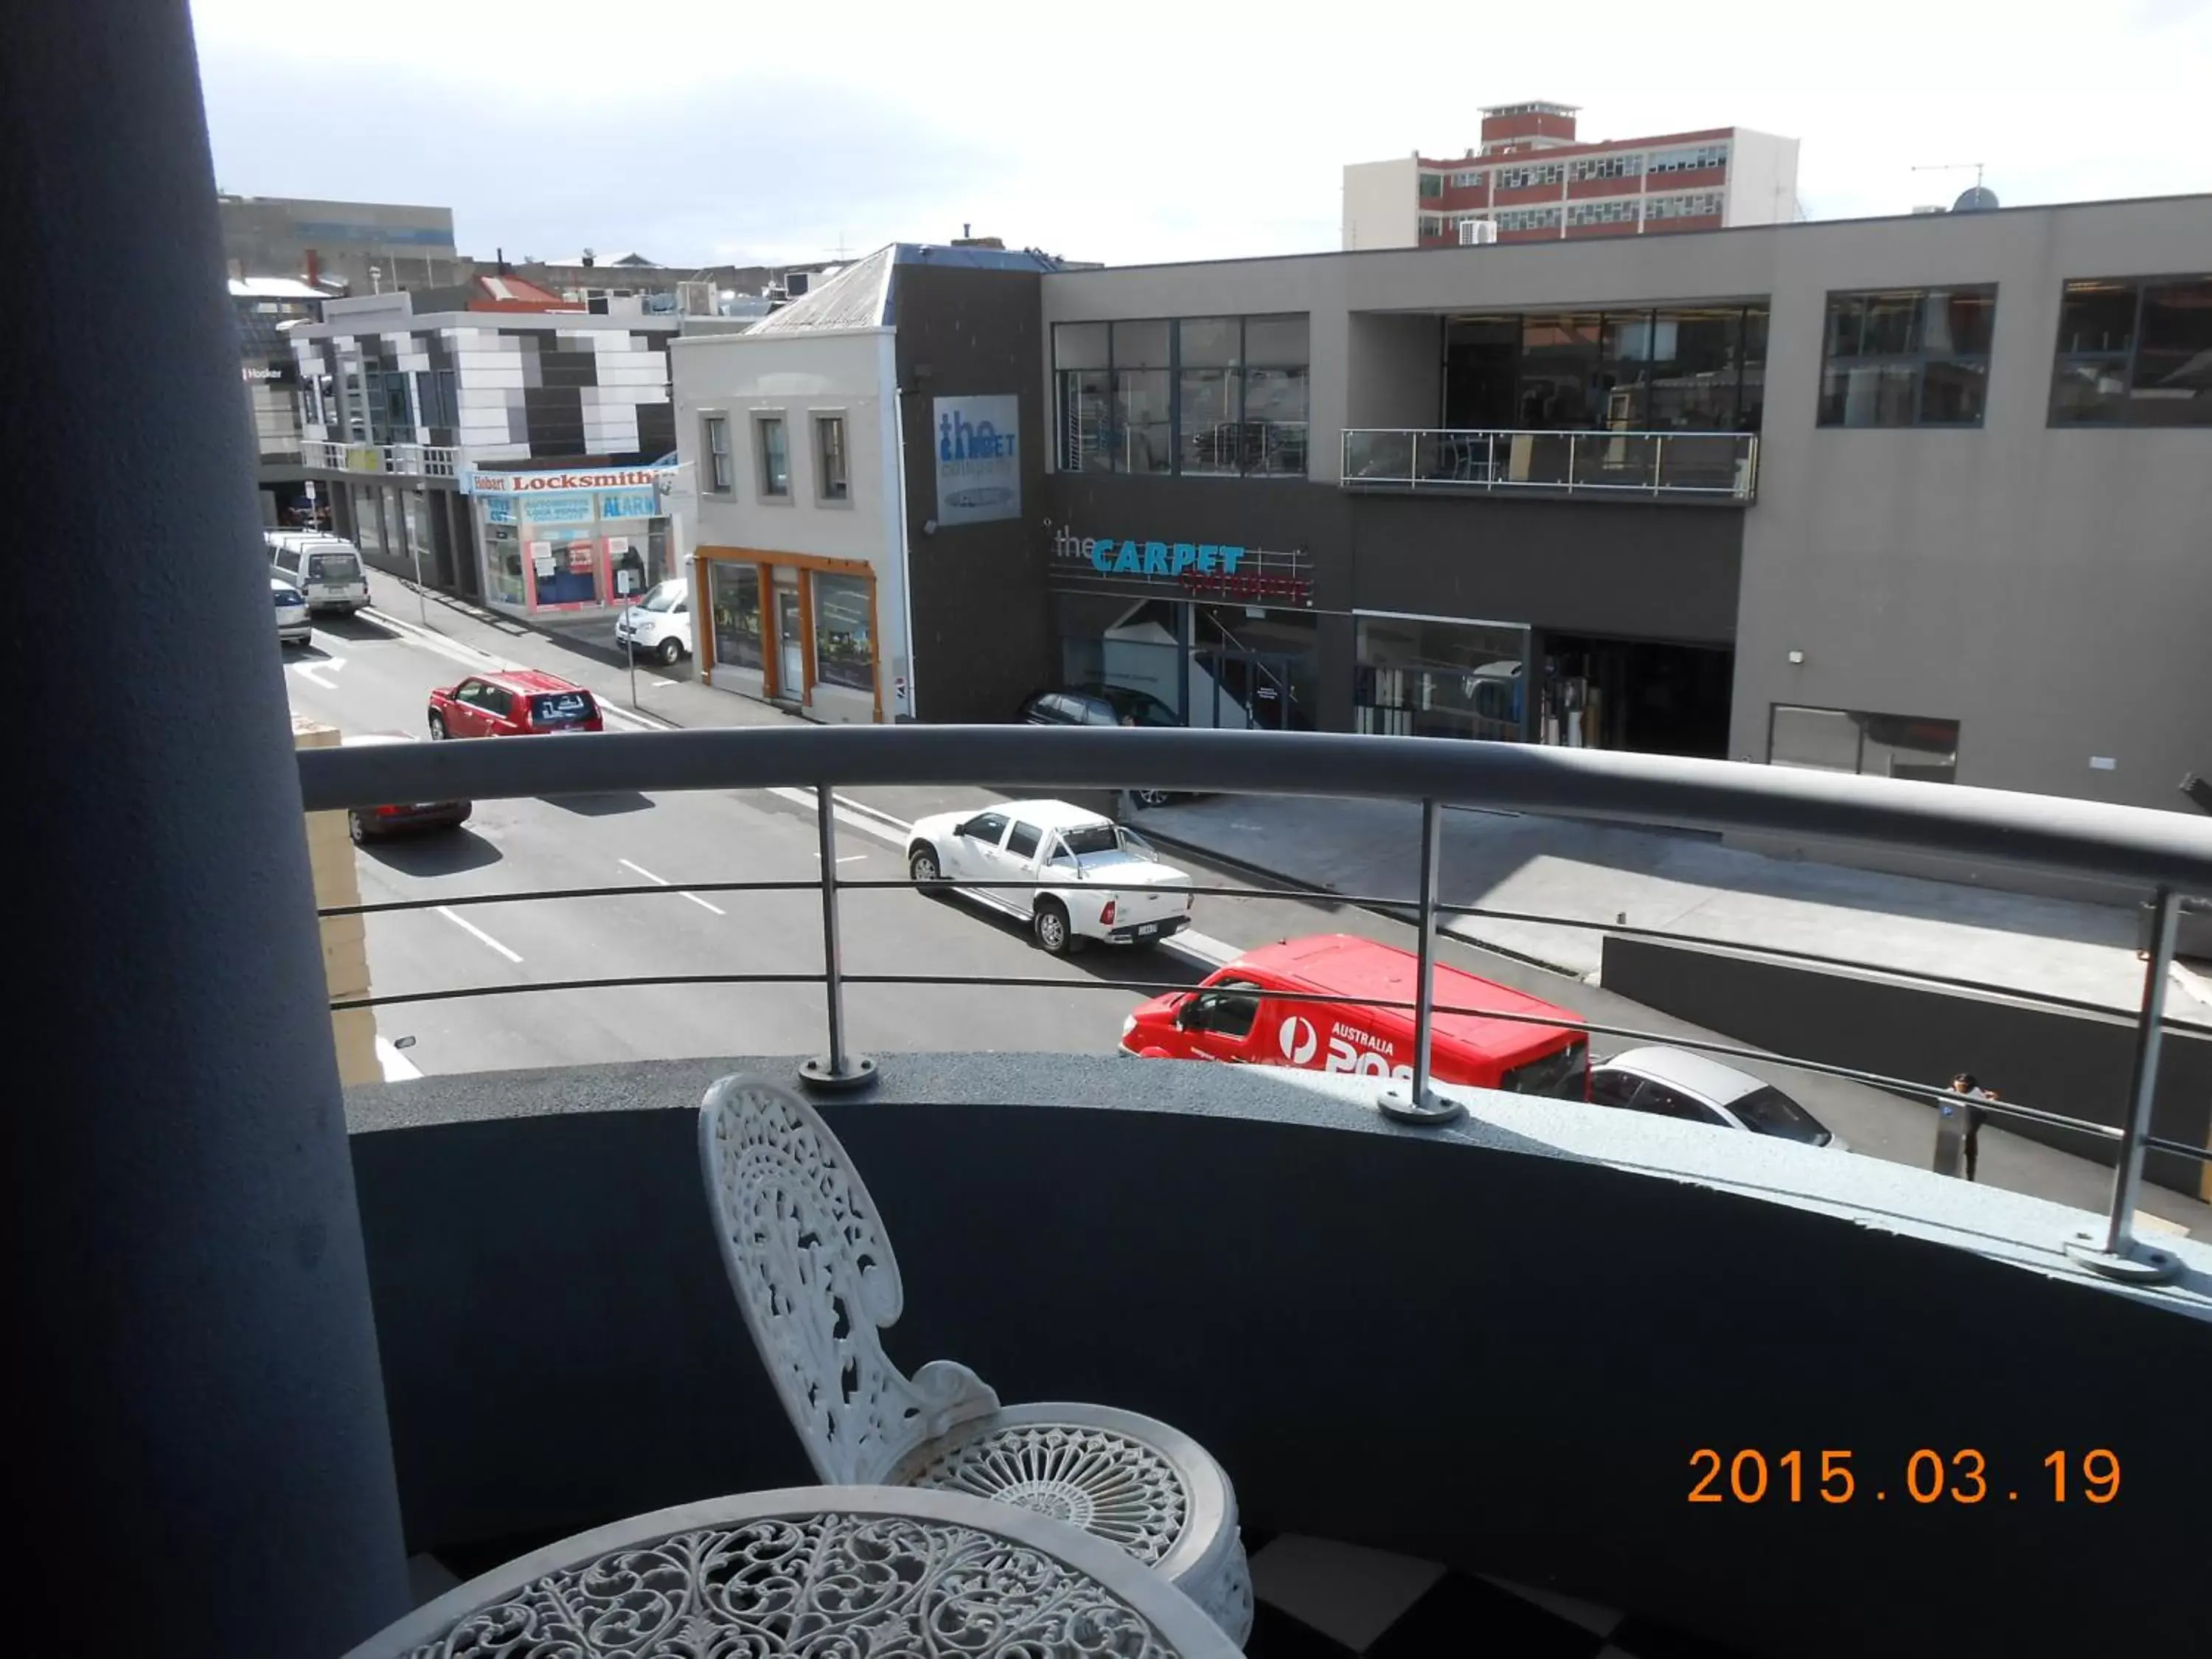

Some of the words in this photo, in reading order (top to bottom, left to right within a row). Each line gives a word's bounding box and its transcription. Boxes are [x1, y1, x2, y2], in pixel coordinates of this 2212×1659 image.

[1054, 525, 1094, 558] the
[1091, 539, 1246, 575] CARPET
[1332, 1021, 1394, 1056] AUSTRALIA
